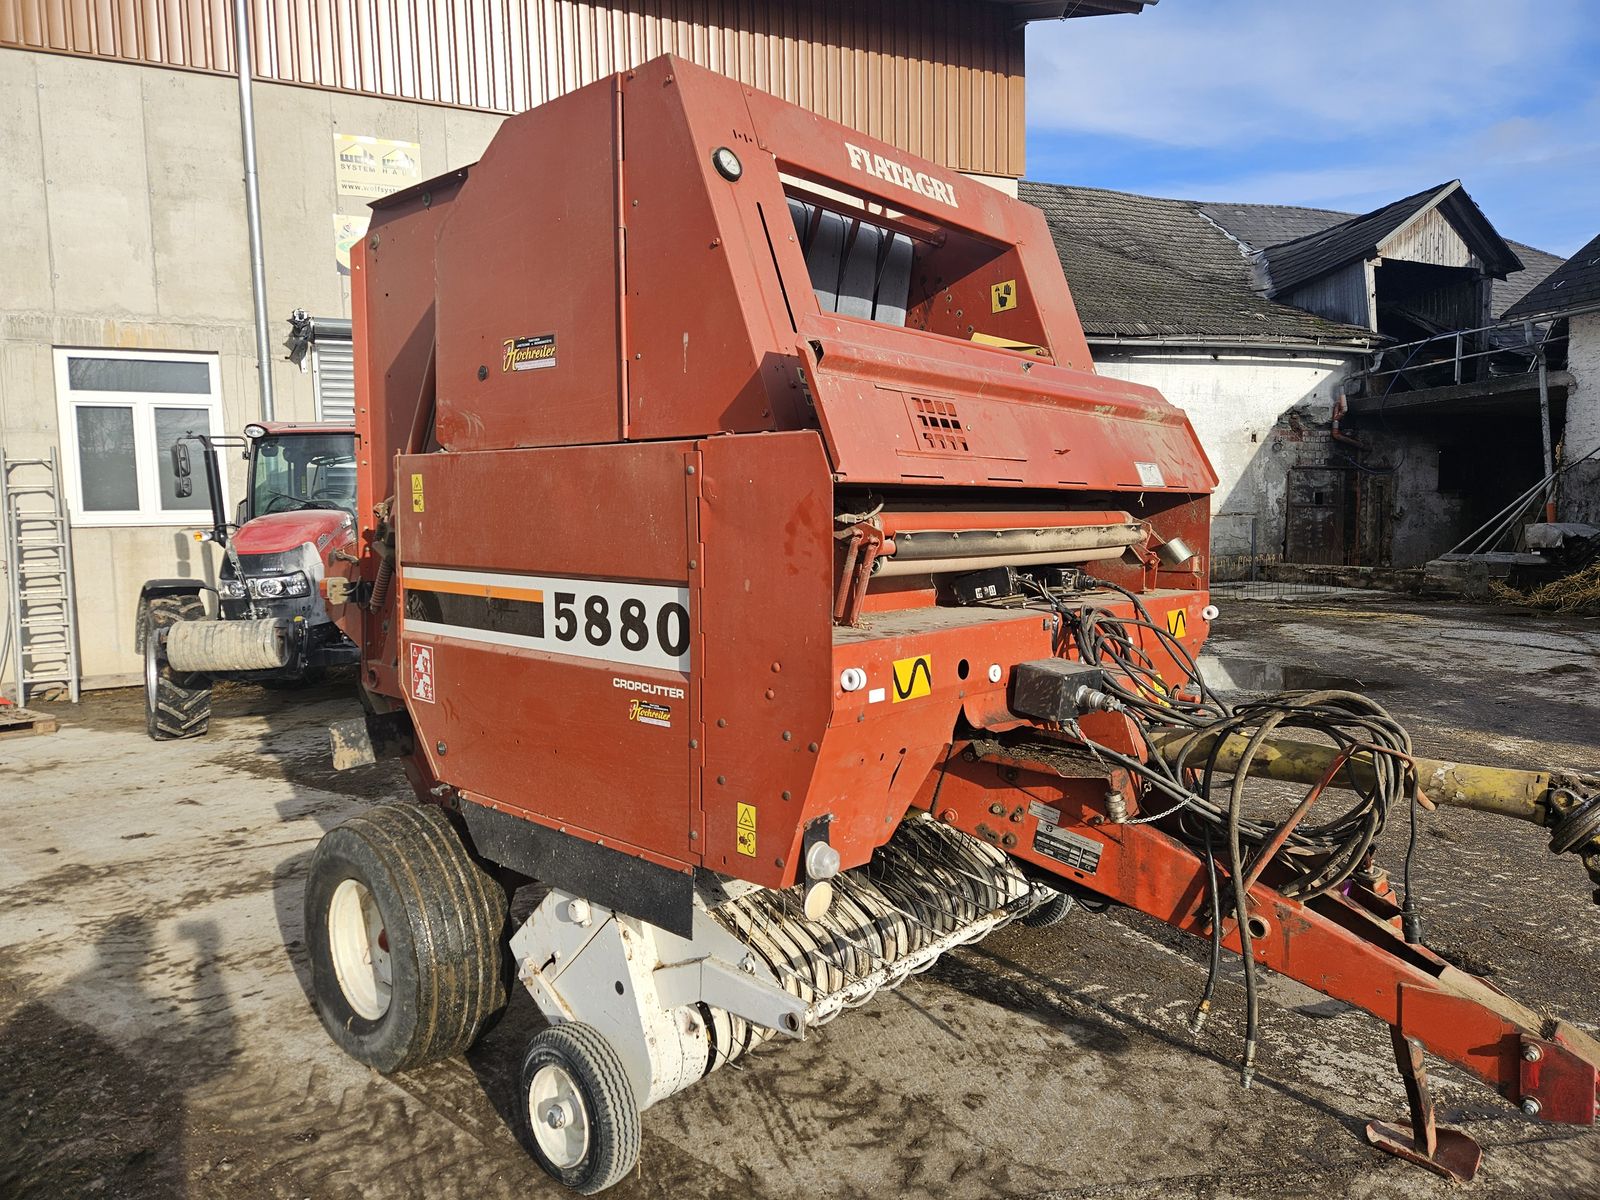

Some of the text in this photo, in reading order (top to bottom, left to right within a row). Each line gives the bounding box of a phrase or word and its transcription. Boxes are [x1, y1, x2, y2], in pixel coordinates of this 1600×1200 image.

[340, 163, 376, 173] SYSTEM
[844, 142, 959, 208] FIATAGRI
[503, 338, 556, 372] Hochreiter
[554, 592, 690, 657] 5880
[613, 677, 684, 699] CROPCUTTER
